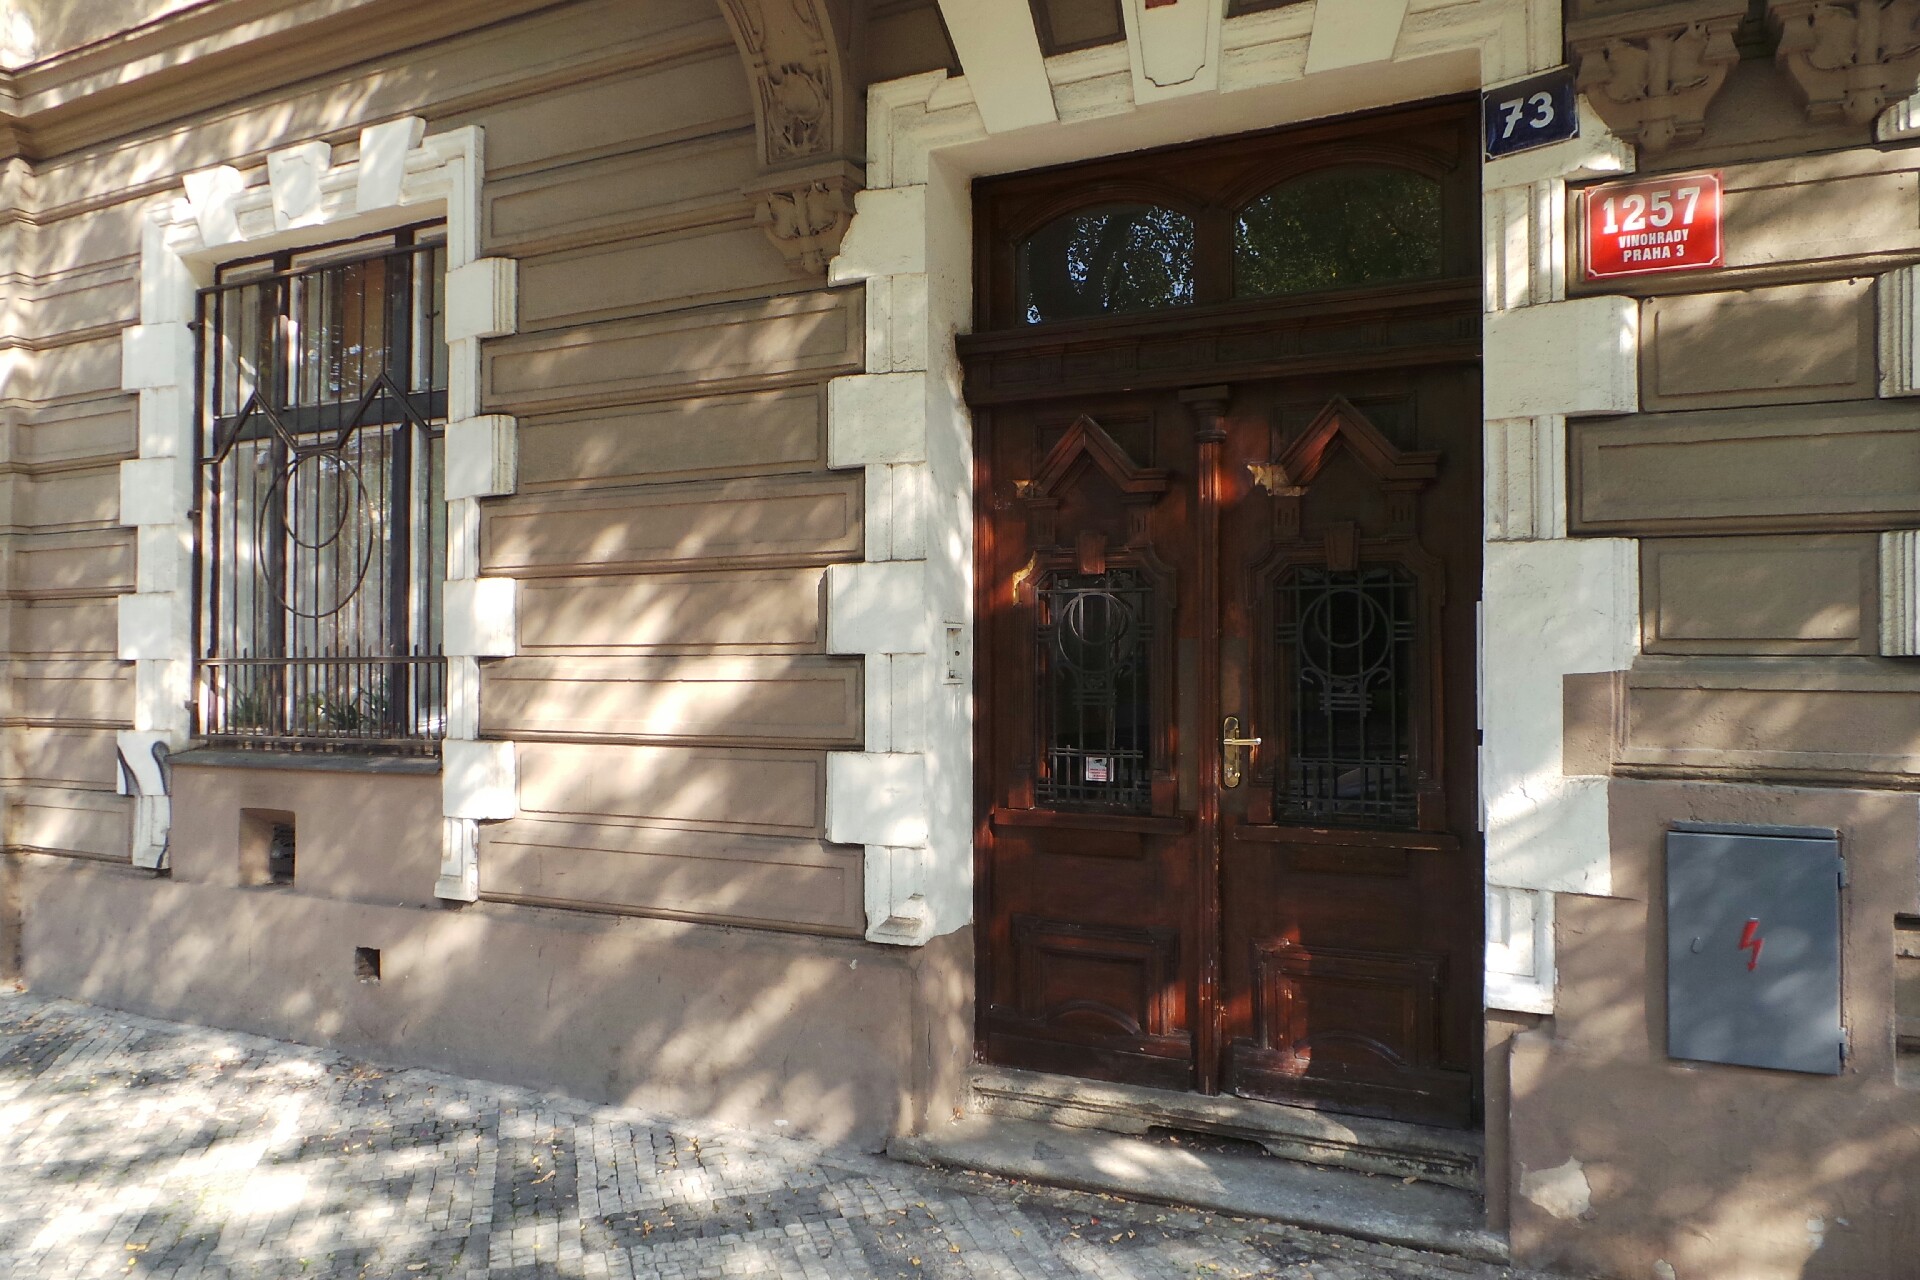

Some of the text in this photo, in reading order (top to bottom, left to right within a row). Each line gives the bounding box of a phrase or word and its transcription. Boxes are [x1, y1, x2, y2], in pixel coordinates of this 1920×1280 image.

[1500, 91, 1555, 139] 73
[1602, 186, 1701, 235] 1257
[1618, 229, 1689, 249] VINOHRADY
[1623, 244, 1685, 263] PRAHA 3
